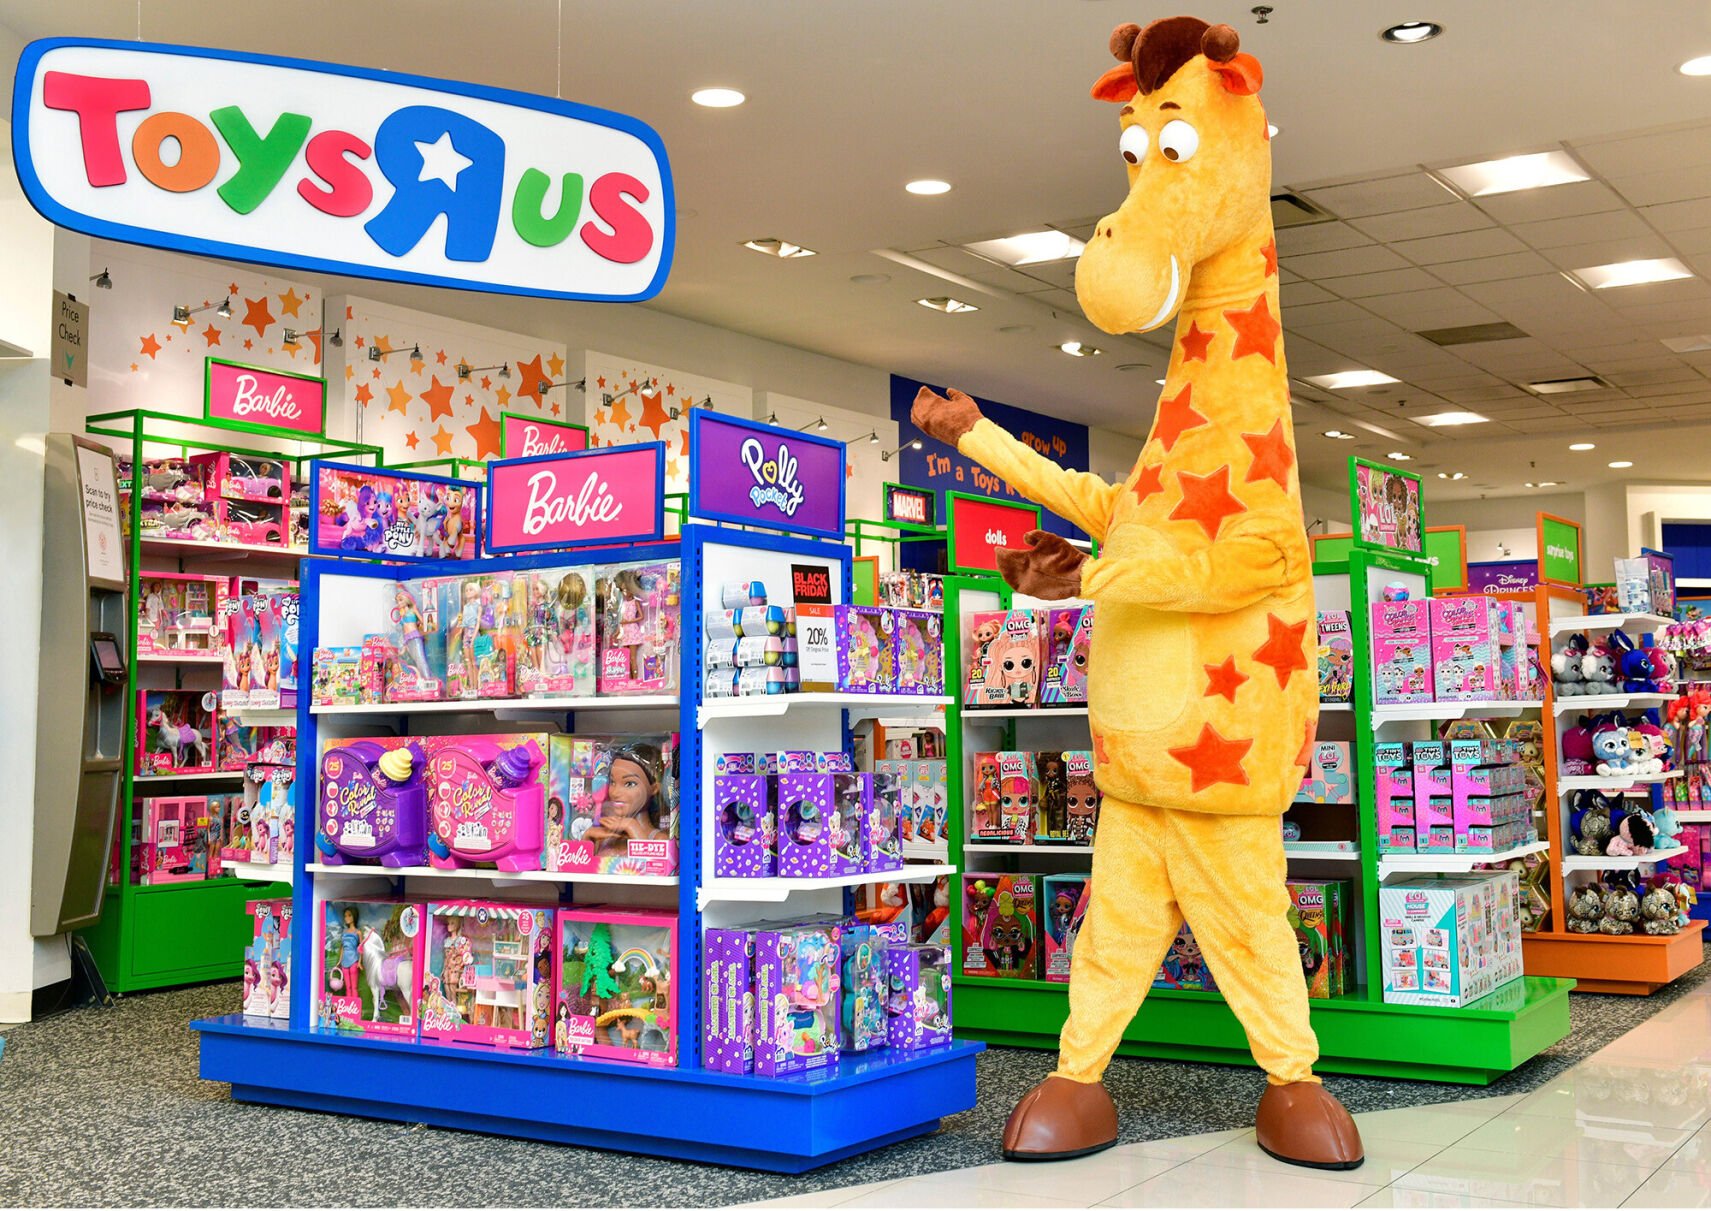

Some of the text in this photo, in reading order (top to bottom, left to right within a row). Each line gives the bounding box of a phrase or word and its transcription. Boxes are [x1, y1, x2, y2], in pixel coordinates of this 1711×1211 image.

[61, 301, 80, 323] Price
[58, 325, 81, 347] Check
[233, 374, 302, 419] Barbie
[1022, 432, 1067, 457] grow up
[742, 438, 804, 516] Polly
[926, 453, 951, 477] I'm
[955, 466, 964, 482] a
[971, 467, 1000, 495] Toys
[85, 484, 97, 496] Scan
[523, 471, 622, 535] Barbie
[750, 485, 788, 512] Pocket
[99, 502, 112, 513] check
[893, 493, 926, 520] MARVEL
[384, 530, 414, 549] PONY
[985, 529, 1007, 546] dolls
[793, 572, 827, 585] BLACK
[1496, 574, 1528, 587] Disney
[795, 585, 828, 597] FRIDAY
[1483, 585, 1535, 593] PRINCES
[809, 607, 821, 615] SALE
[1007, 621, 1031, 630] OMG
[1321, 623, 1347, 633] TWEENS
[806, 628, 829, 645] 20%
[606, 650, 627, 664] Barbie
[971, 669, 983, 678] 20
[1048, 667, 1059, 678] 20
[1377, 753, 1402, 761] TOYS
[1416, 752, 1441, 761] TOYS
[1454, 751, 1480, 760] TOYS
[441, 761, 453, 771] 25
[1003, 762, 1023, 771] OMG
[1068, 762, 1090, 771] OMG
[340, 782, 370, 805] Color
[453, 783, 485, 807] Color
[557, 842, 592, 866] Barbie
[630, 843, 665, 852] TIE-DYE
[1014, 884, 1034, 893] OMG
[1298, 895, 1323, 905] OMG
[336, 998, 360, 1015] Barbie
[423, 1009, 453, 1032] Barbie
[568, 1017, 594, 1036] Barbie
